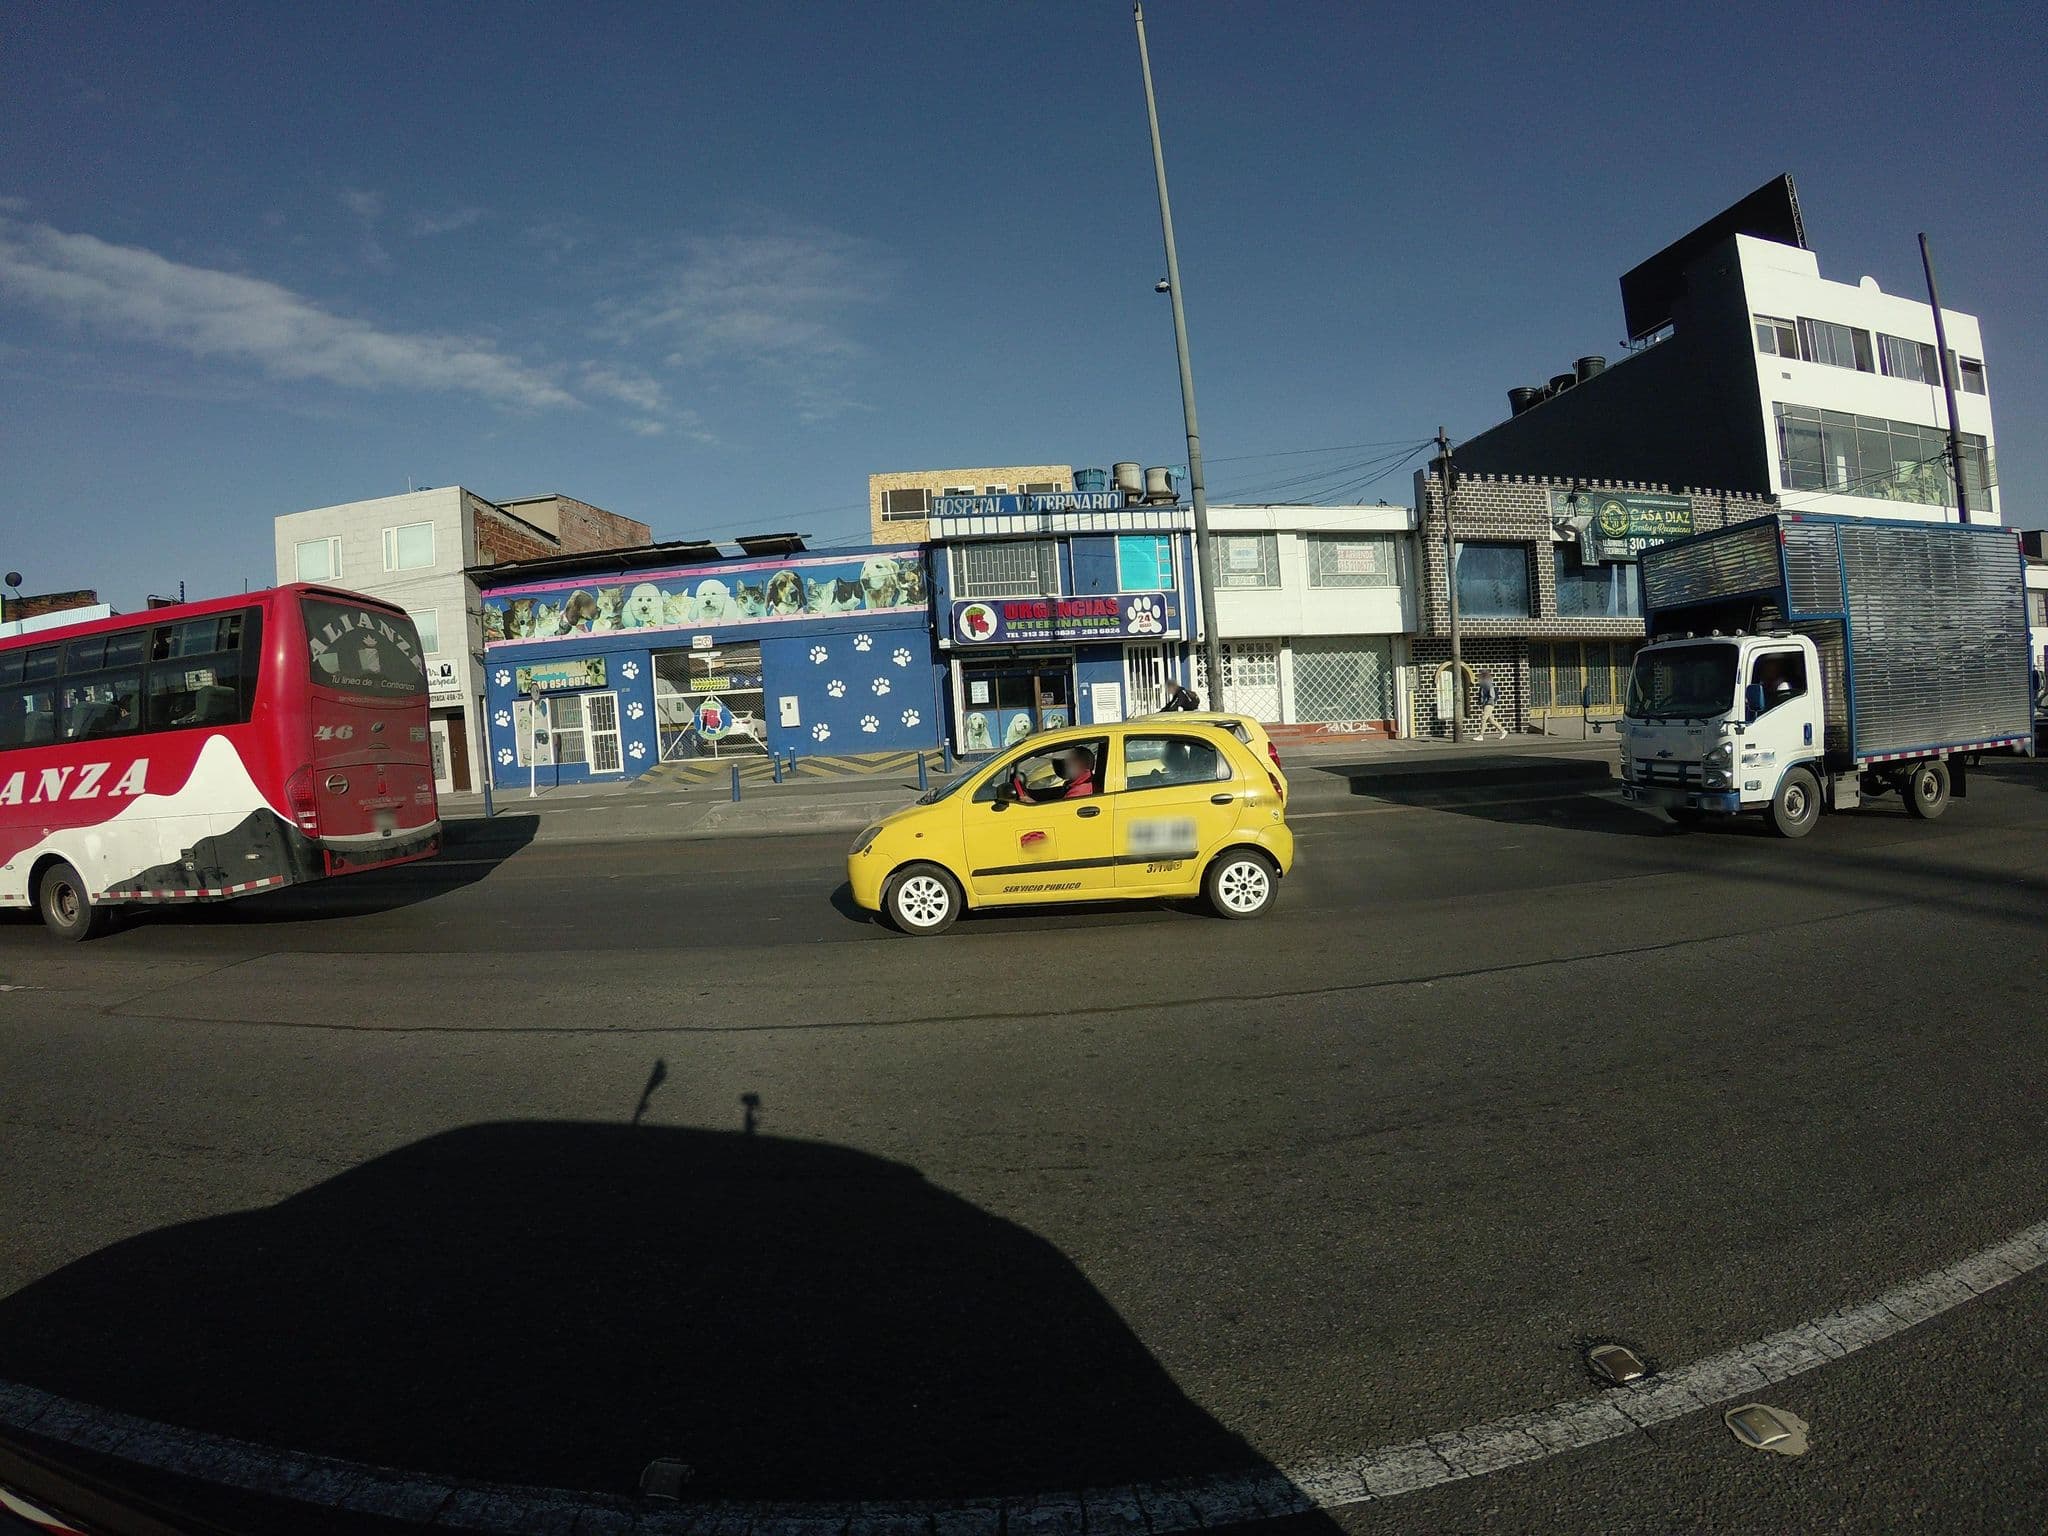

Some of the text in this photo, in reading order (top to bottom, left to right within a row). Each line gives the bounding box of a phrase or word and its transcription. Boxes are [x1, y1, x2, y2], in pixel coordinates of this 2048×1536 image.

[934, 493, 1119, 516] HOSPITAL VETERINARIO
[1630, 508, 1690, 524] CASA DIAZ
[1629, 537, 1646, 550] 310
[1004, 598, 1120, 620] URGENCIAS
[1006, 617, 1120, 630] VETERINARIAS
[1138, 614, 1151, 623] 24
[314, 725, 353, 741] 46
[0, 758, 149, 806] ANZA
[1003, 881, 1081, 893] SERVICIO PUBLICO
